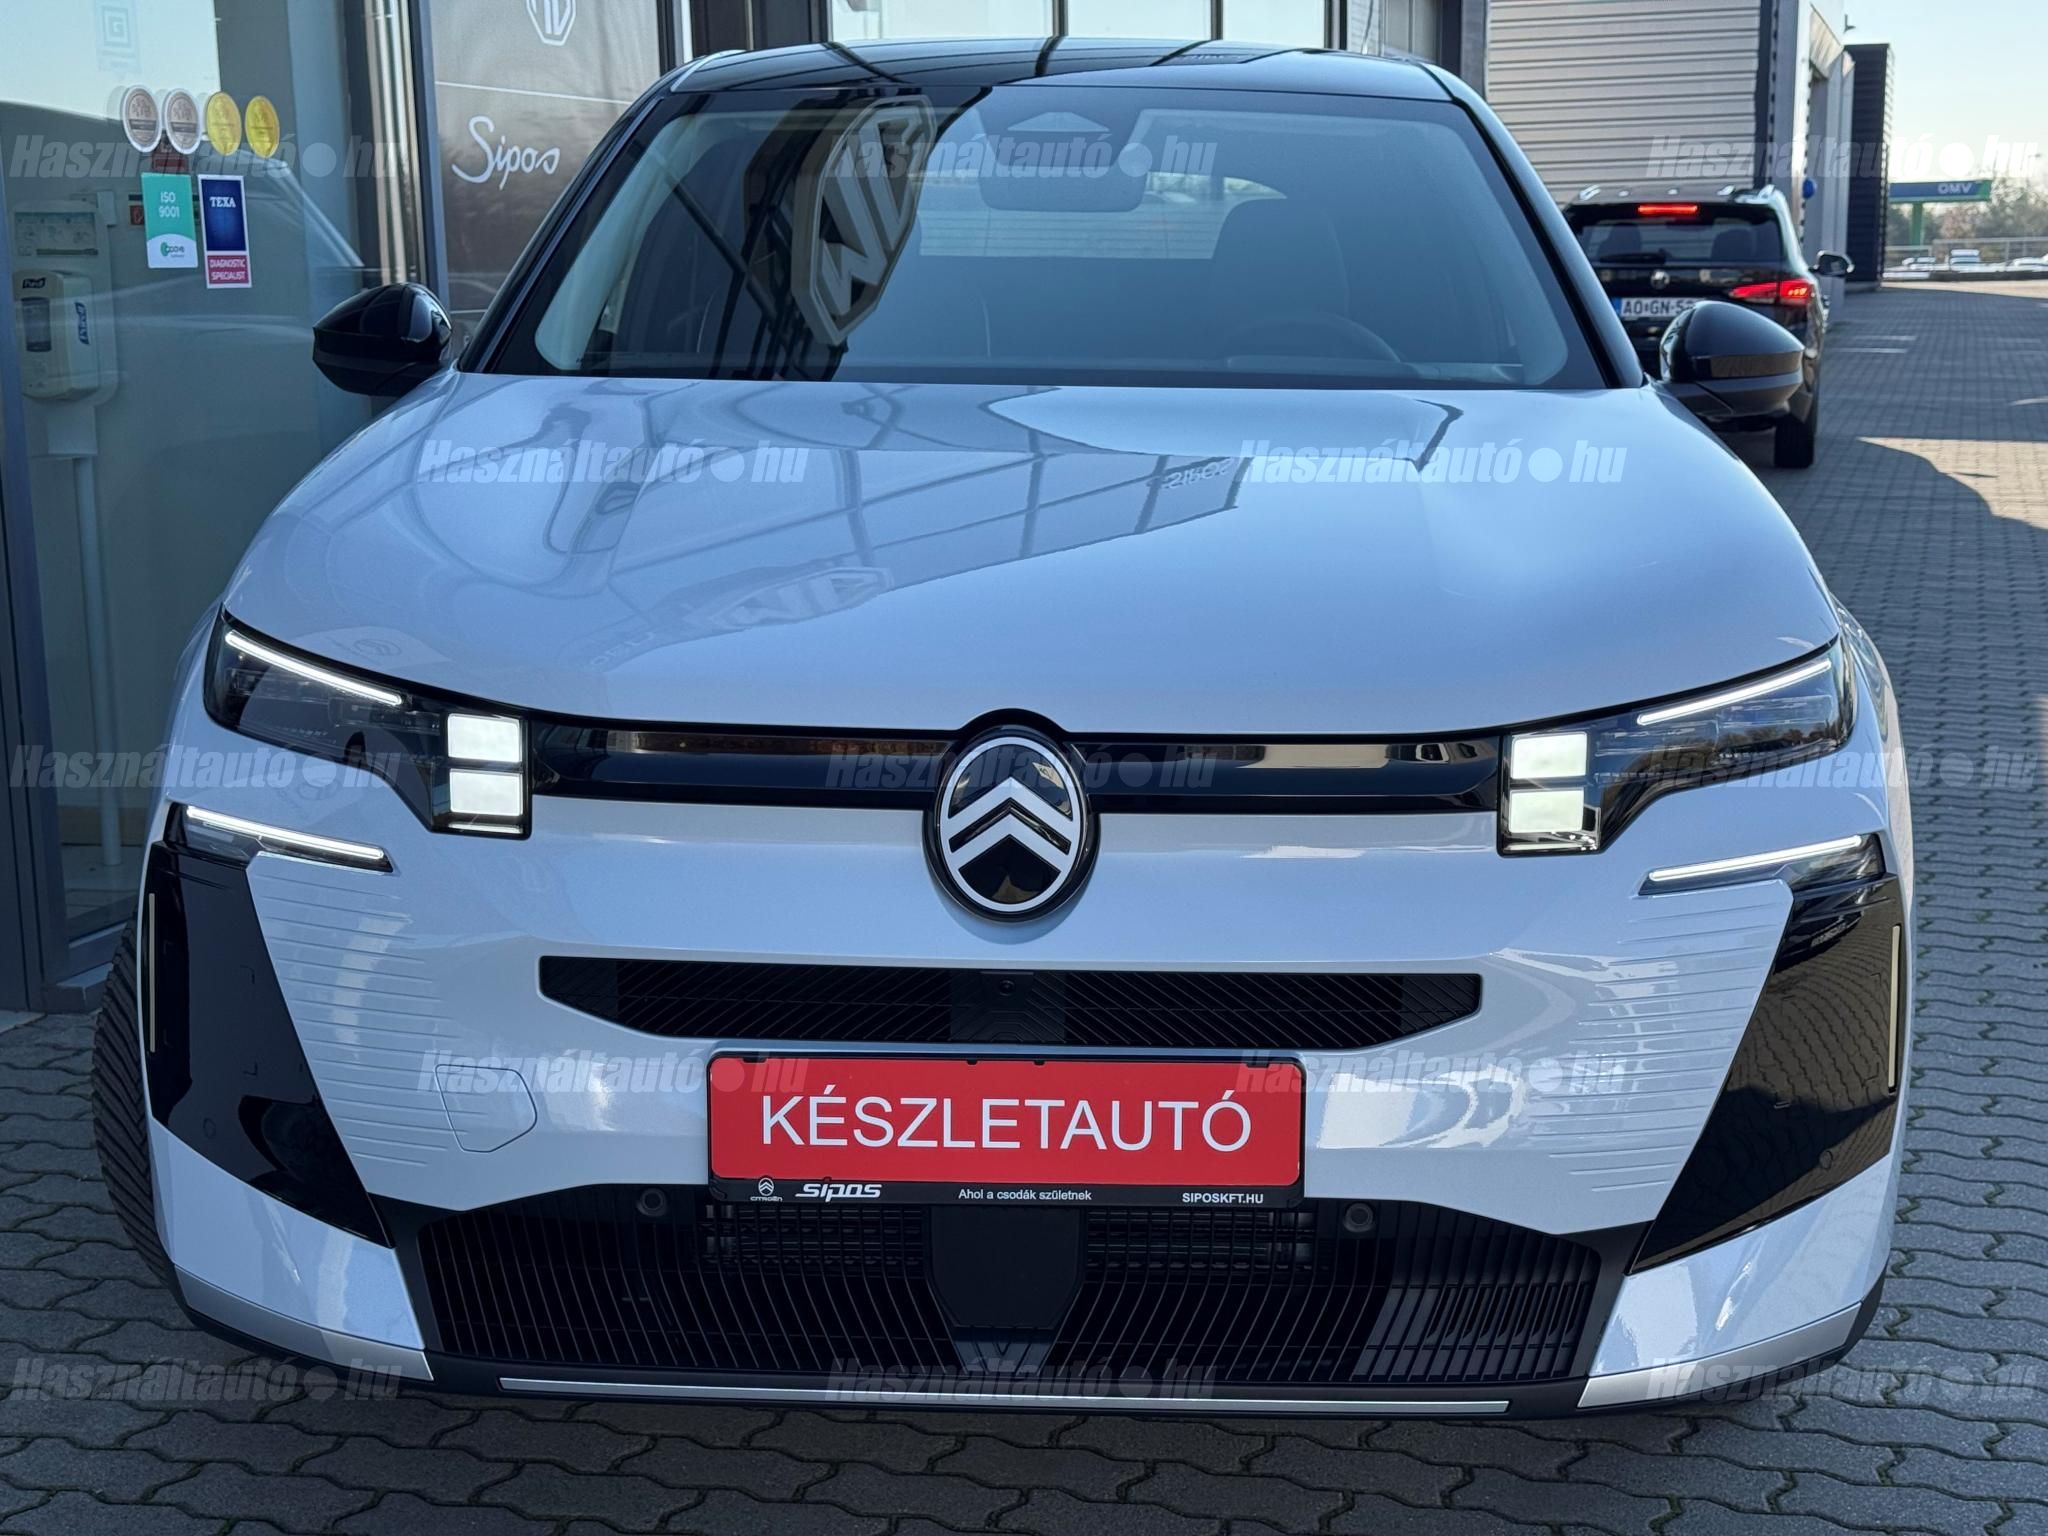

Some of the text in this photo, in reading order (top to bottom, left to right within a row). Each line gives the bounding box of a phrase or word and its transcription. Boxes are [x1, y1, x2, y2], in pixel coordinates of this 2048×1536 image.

[452, 115, 561, 190] Sipos
[1938, 183, 1972, 194] OMV
[160, 191, 176, 203] ISO
[209, 196, 236, 208] TEXA
[158, 206, 180, 218] 9001
[209, 259, 246, 268] DIAGNOSTIC
[211, 271, 246, 280] SPECIALIST
[762, 1084, 1252, 1152] KÉSZLETAUTÓ
[958, 1188, 1092, 1201] Ahol a csodák születnek
[1181, 1192, 1264, 1204] SIPOSKFT.HU
